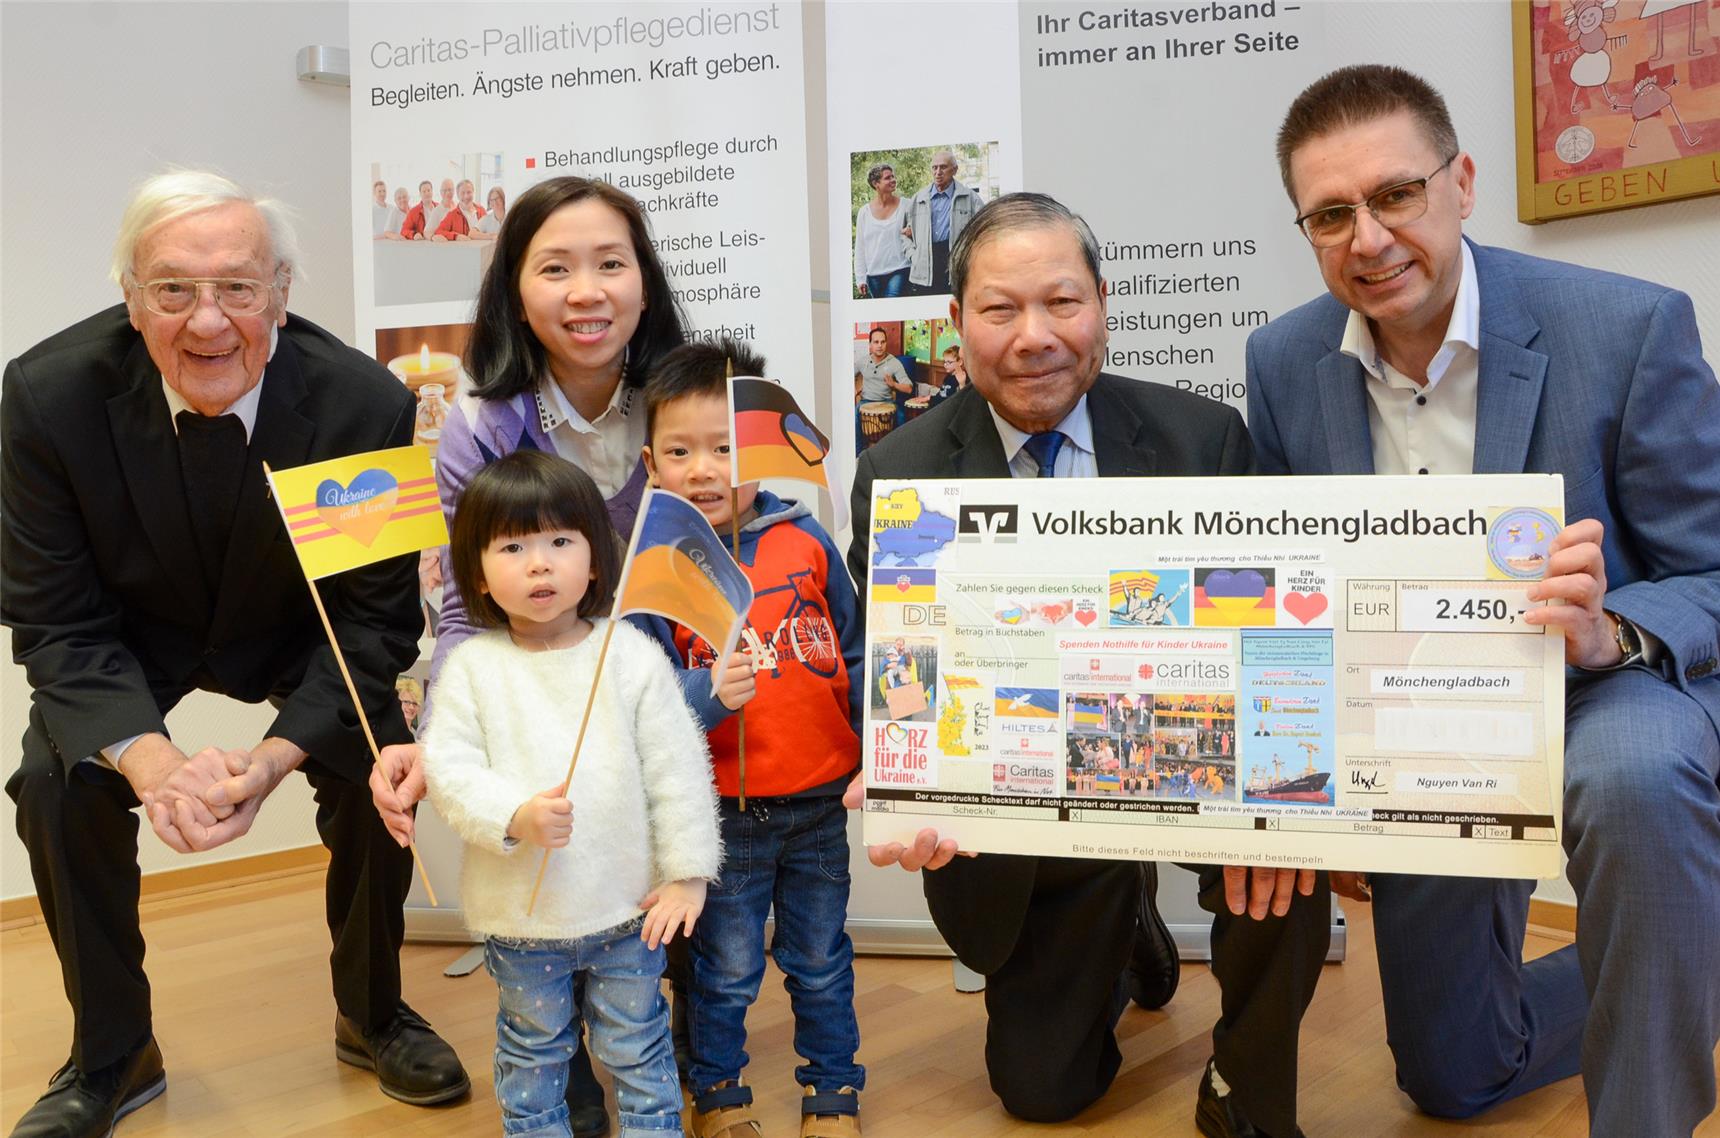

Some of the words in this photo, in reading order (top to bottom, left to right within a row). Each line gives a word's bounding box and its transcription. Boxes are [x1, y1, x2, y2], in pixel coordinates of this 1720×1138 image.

[1036, 13, 1070, 35] Ihr
[1078, 2, 1276, 32] Caritasverband
[370, 3, 780, 70] Caritas-Palliativpflegedienst
[1037, 45, 1117, 68] immer
[1125, 41, 1157, 62] an
[1165, 34, 1225, 59] Ihrer
[1233, 30, 1300, 54] Seite
[370, 78, 465, 108] Begleiten.
[472, 71, 544, 98] Ängste
[551, 65, 642, 90] nehmen.
[649, 56, 698, 80] Kraft
[706, 51, 781, 78] geben.
[545, 139, 719, 168] Behandlungspflege
[725, 134, 778, 155] durch
[619, 165, 735, 190] ausgebildete
[1554, 167, 1667, 206] GEBEN
[650, 232, 713, 252] erische
[720, 229, 766, 248] Leis-
[1213, 239, 1257, 257] uns
[1106, 272, 1240, 296] ualifizierten
[670, 283, 761, 304] mosphäre
[1105, 310, 1222, 335] eistungen
[1232, 308, 1269, 327] um
[1175, 377, 1247, 402] Regio
[325, 487, 376, 507] Ukraine
[1032, 510, 1184, 536] Volksbank
[1194, 509, 1488, 543] Mönchengladbach
[1287, 577, 1308, 585] HERZ
[1310, 576, 1326, 585] FÜR
[1300, 569, 1314, 577] EIN
[956, 583, 988, 593] Zahlen
[990, 583, 1004, 593] Sie
[1006, 585, 1036, 595] gegen
[1039, 583, 1069, 593] diesen
[1072, 584, 1104, 594] Scheck
[1353, 583, 1391, 592] Währung
[903, 605, 947, 626] DE
[1353, 602, 1390, 616] EUR
[955, 628, 983, 638] Betrag
[985, 628, 994, 636] in
[995, 628, 1045, 638] Buchstaben
[1059, 640, 1100, 650] Spenden
[1103, 640, 1139, 649] Nothilfe
[1141, 640, 1154, 649] für
[1157, 640, 1189, 649] Kinder
[1191, 640, 1228, 649] Ukraine
[954, 659, 974, 668] oder
[977, 658, 1029, 670] Überbringer
[1156, 659, 1230, 679] caritas
[1346, 666, 1360, 674] Ort
[1063, 673, 1089, 681] caritas
[1156, 678, 1230, 688] international
[1383, 675, 1511, 690] Mönchengladbach
[874, 747, 899, 768] für
[903, 748, 928, 770] die
[1346, 759, 1392, 767] Unterschrift
[874, 769, 915, 784] Ukraine
[1010, 764, 1054, 778] Caritas
[1416, 778, 1458, 789] Nguyen
[1462, 779, 1482, 788] Van
[1485, 779, 1497, 788] Ri
[915, 792, 929, 800] Der
[931, 794, 980, 804] vorgedruckte
[982, 795, 1023, 805] Schecktext
[1025, 797, 1040, 806] darf
[1043, 798, 1061, 807] nicht
[1063, 799, 1098, 810] geändert
[1099, 801, 1118, 809] oder
[1120, 801, 1161, 812] gestrichen
[1163, 804, 1194, 812] werden.
[953, 806, 998, 816] Scheck-Nr.
[1156, 815, 1179, 824] IBAN
[1392, 813, 1405, 823] gilt
[1407, 813, 1419, 821] als
[1422, 814, 1442, 822] nicht
[1444, 815, 1499, 825] geschrieben.
[1353, 824, 1384, 834] Betrag
[1489, 828, 1509, 837] Text
[1072, 844, 1094, 853] Bitte
[1098, 846, 1129, 855] dieses
[1133, 847, 1154, 856] Feld
[1157, 848, 1181, 857] nicht
[1184, 850, 1240, 860] beschriften
[1244, 852, 1262, 861] und
[1265, 854, 1323, 864] bestempeln
